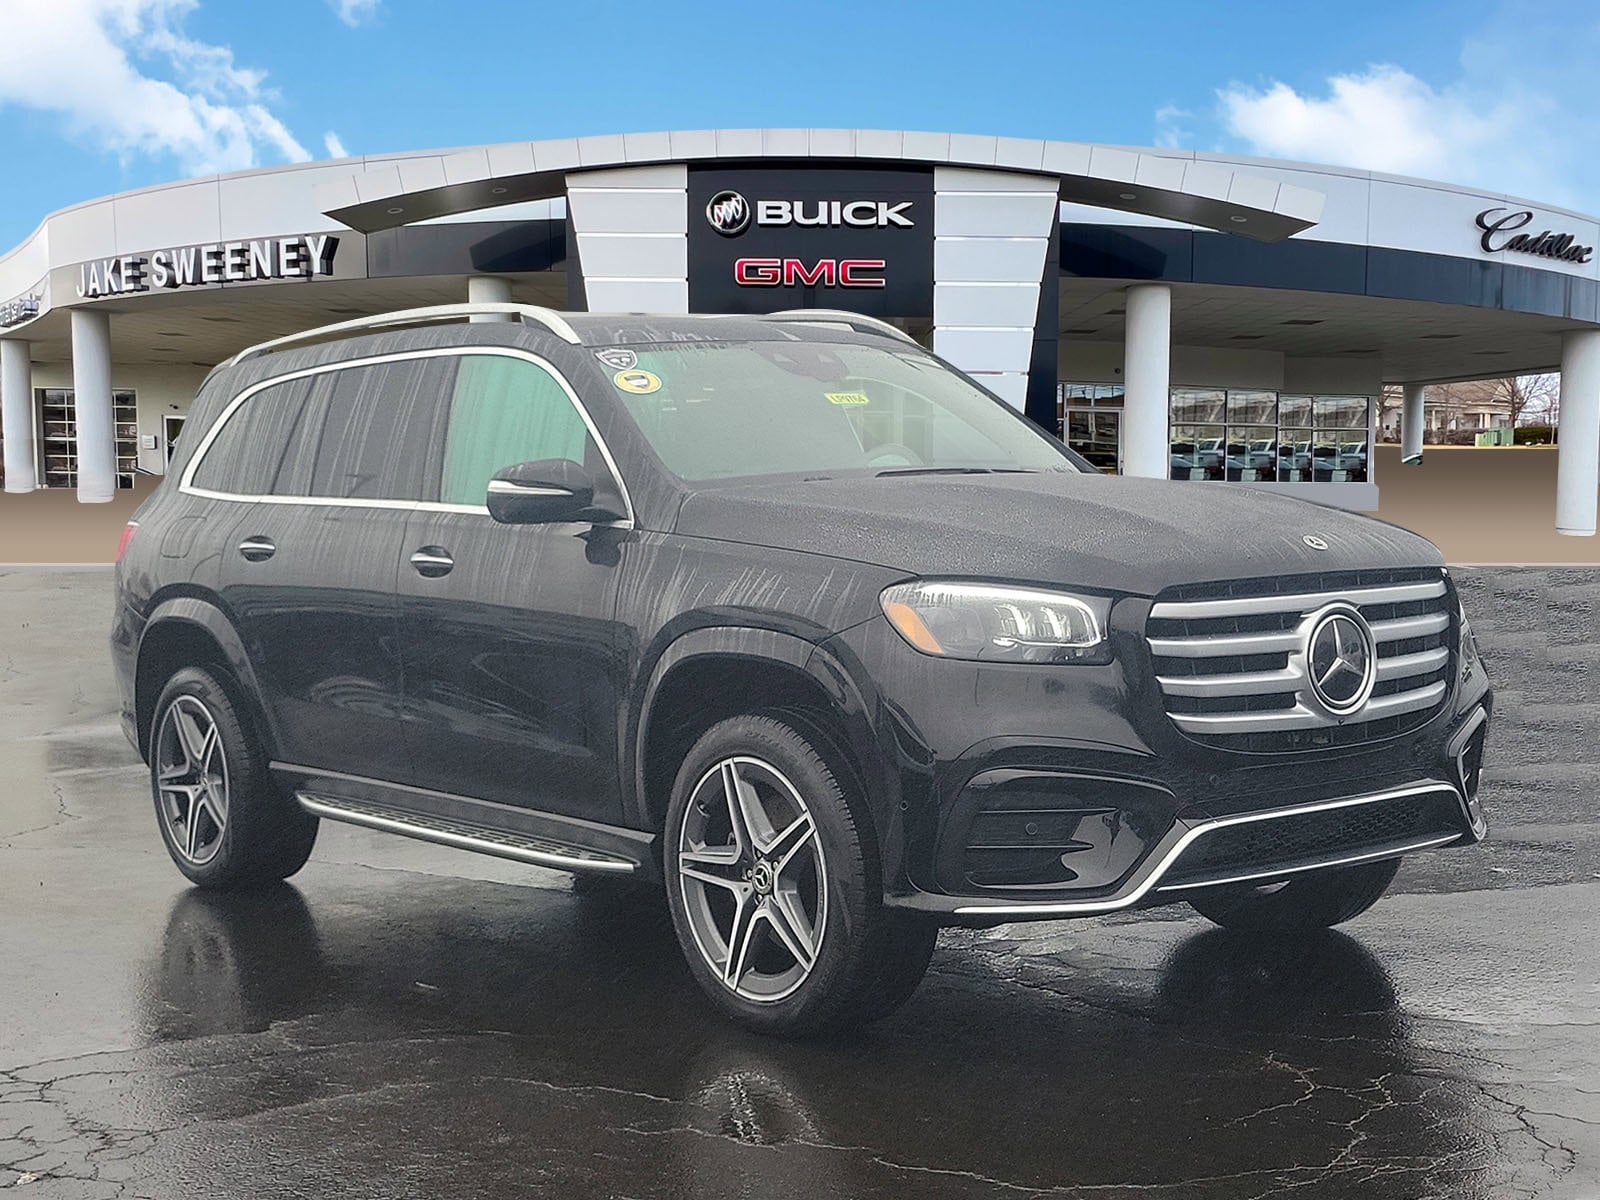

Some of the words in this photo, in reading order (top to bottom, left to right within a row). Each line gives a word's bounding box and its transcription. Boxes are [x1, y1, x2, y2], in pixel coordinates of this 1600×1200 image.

[757, 200, 915, 226] BUICK
[1475, 207, 1593, 264] Cadillac
[76, 256, 146, 299] JAKE
[151, 235, 337, 288] SWEENEY
[735, 258, 886, 287] GMC
